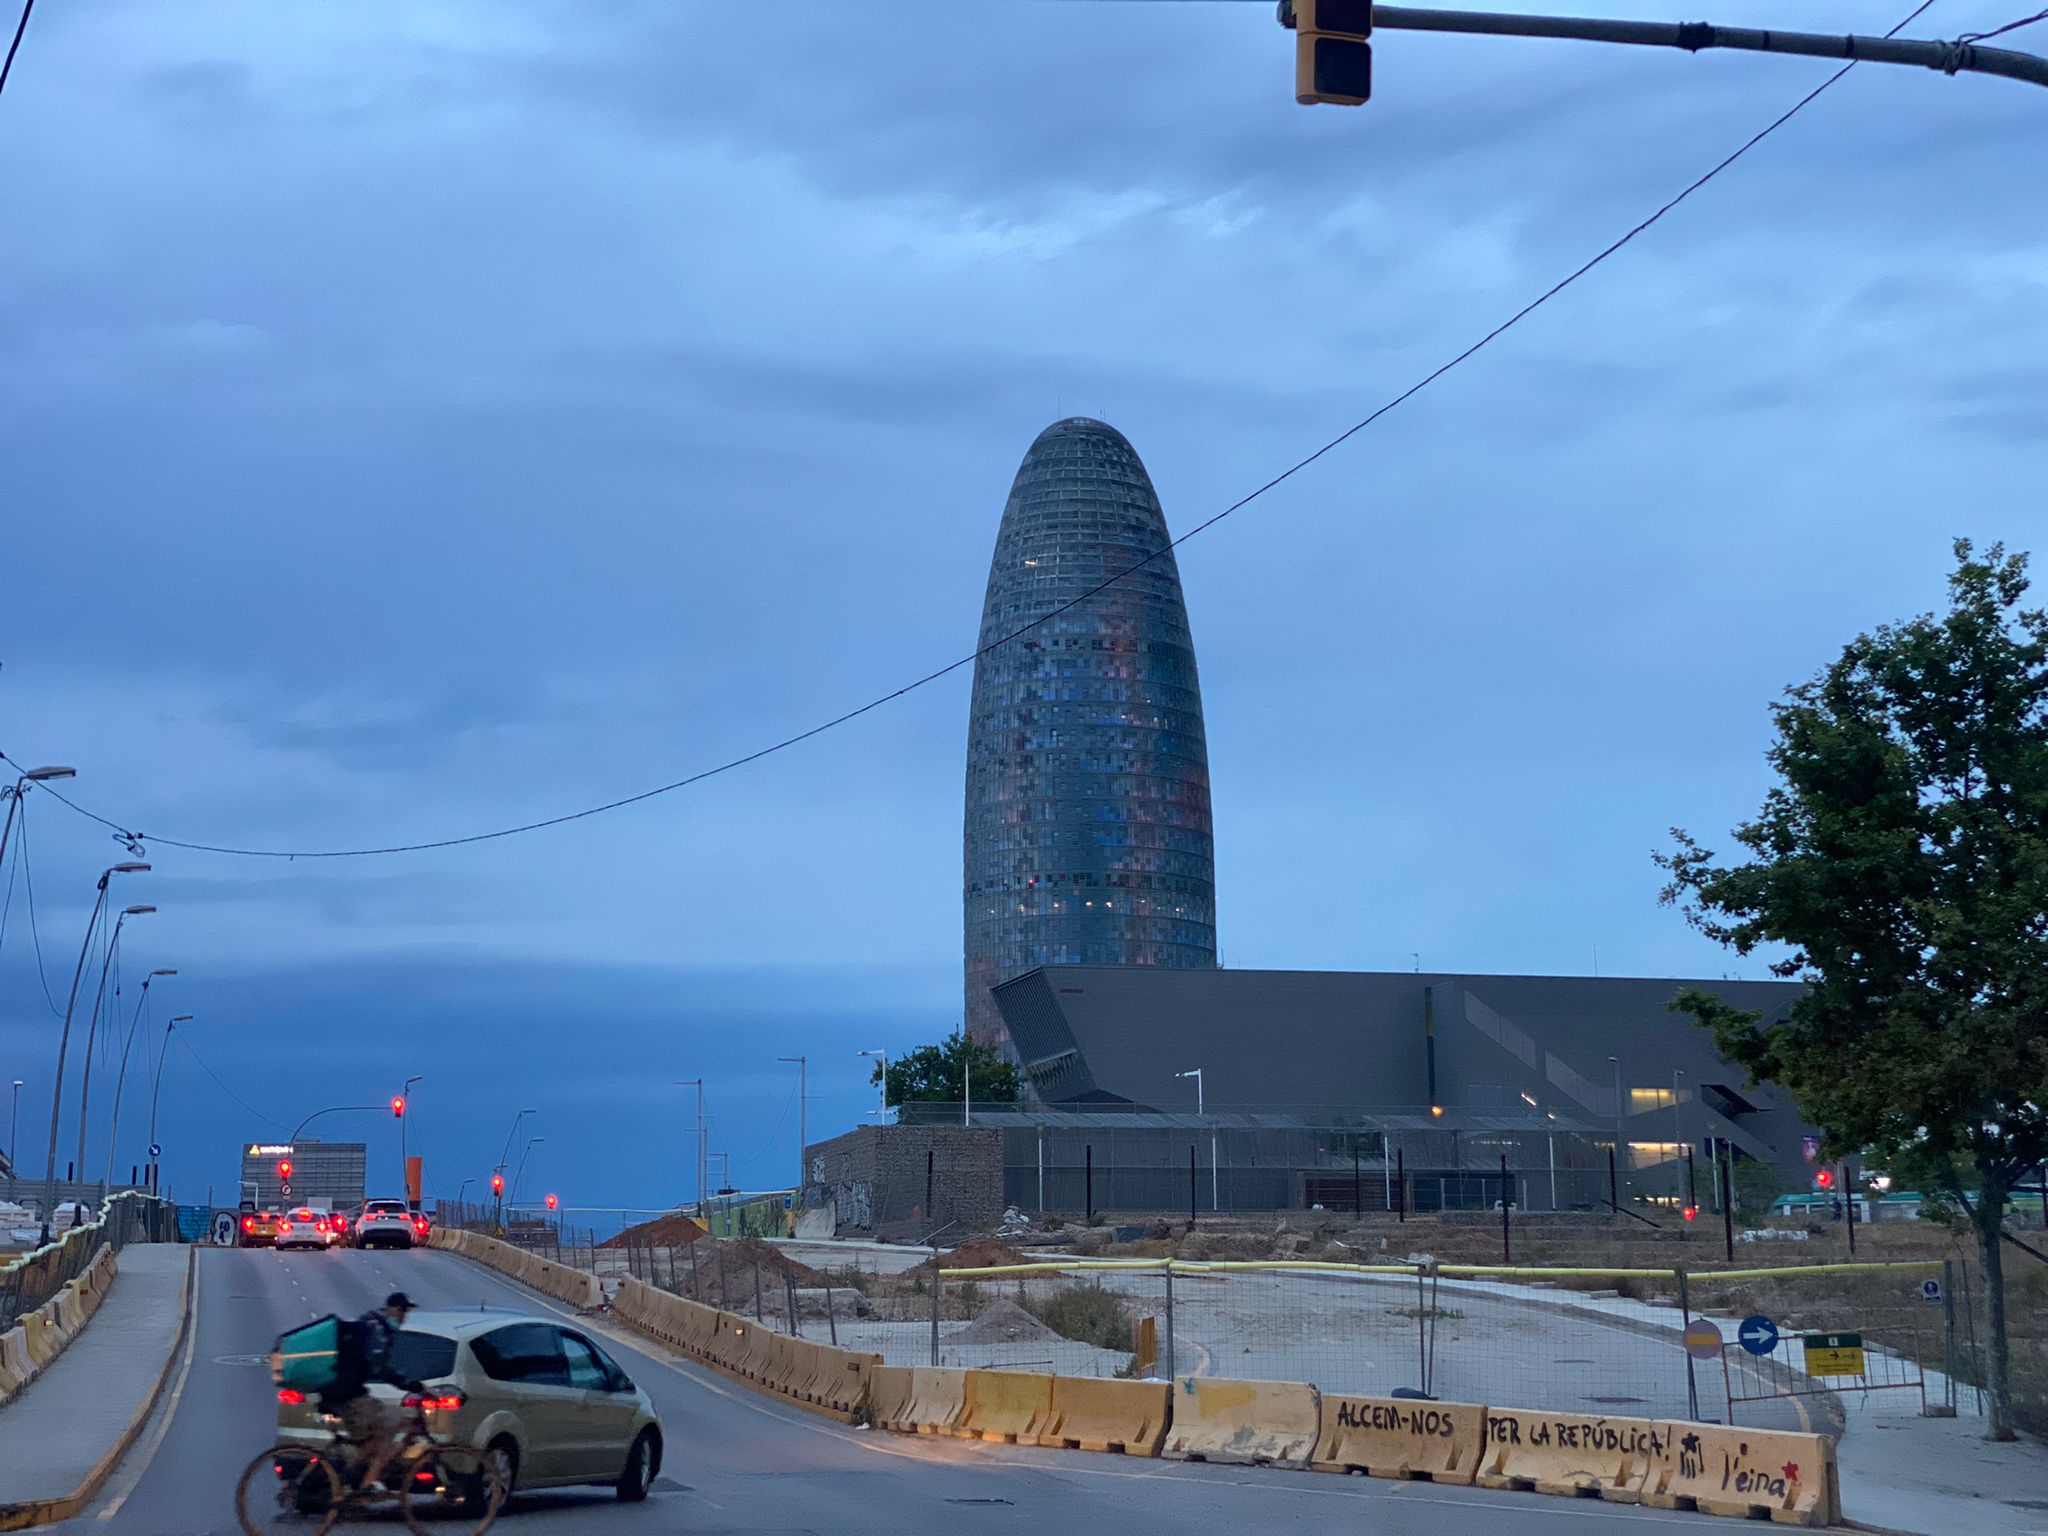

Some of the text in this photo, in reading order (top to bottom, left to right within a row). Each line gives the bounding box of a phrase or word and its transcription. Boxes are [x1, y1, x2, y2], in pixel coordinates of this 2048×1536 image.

[1337, 1401, 1455, 1437] ALCEM-NOS
[1488, 1416, 1521, 1445] PER
[1530, 1421, 1551, 1446] LA
